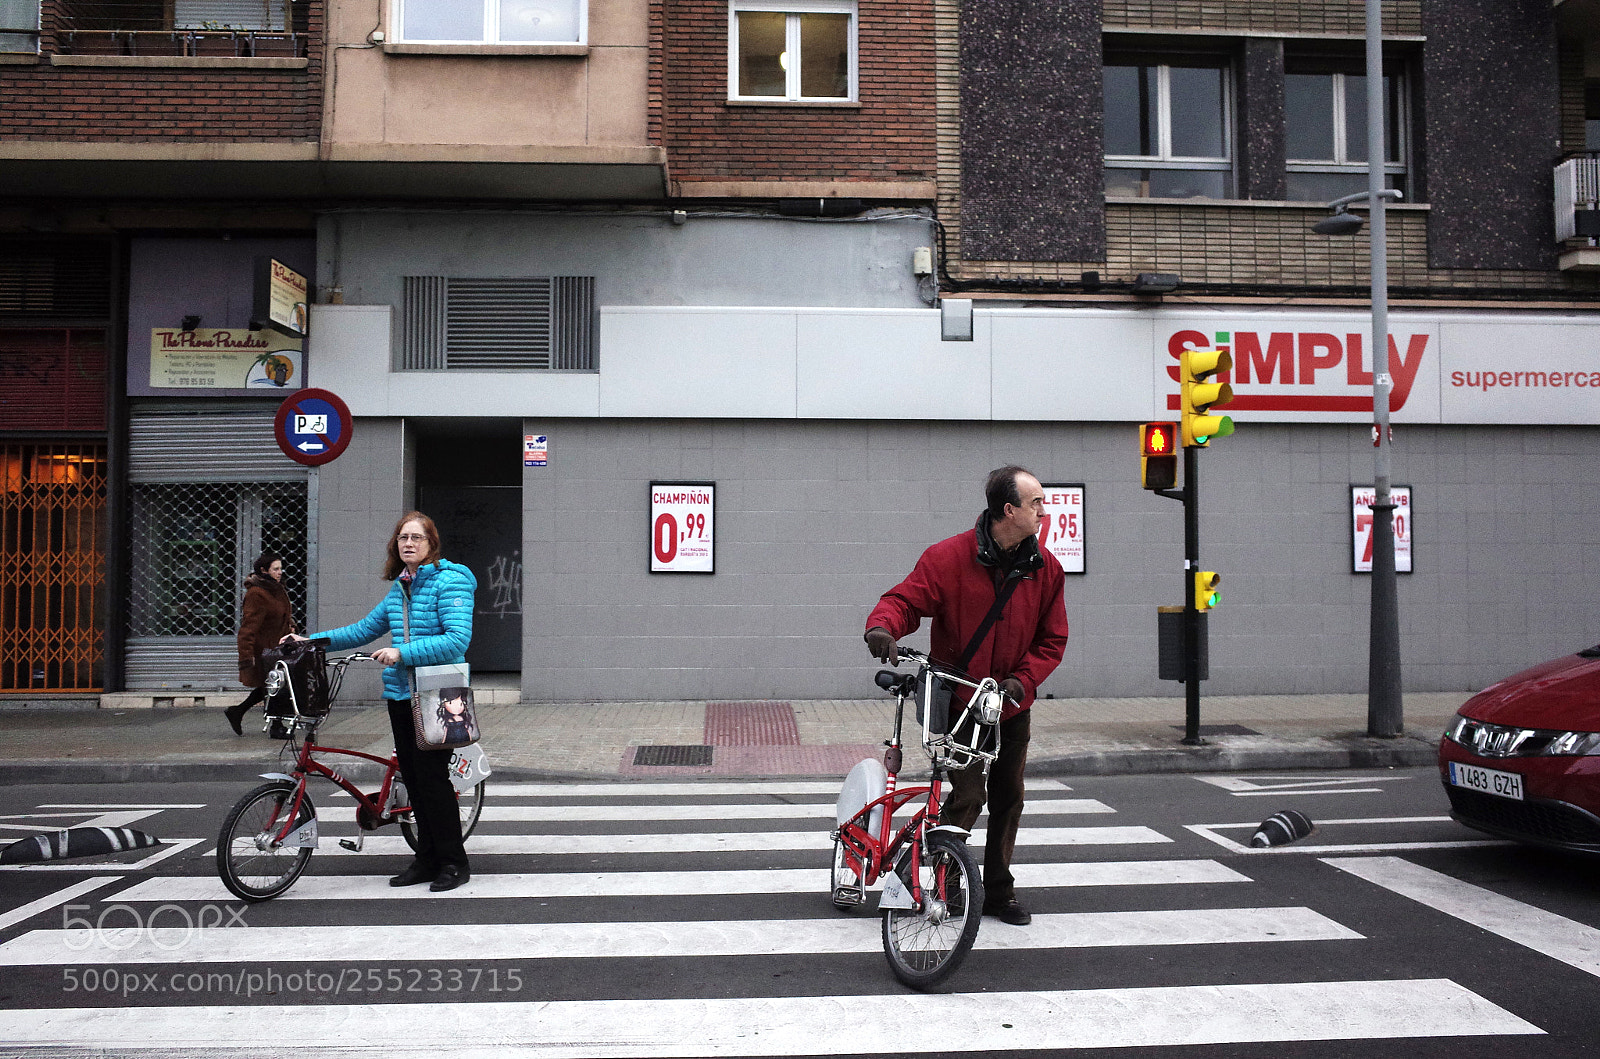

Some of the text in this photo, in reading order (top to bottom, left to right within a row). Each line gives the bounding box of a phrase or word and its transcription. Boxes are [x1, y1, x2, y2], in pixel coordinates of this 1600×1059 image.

[156, 331, 269, 348] The Phone Paradise
[1451, 370, 1600, 392] supermerca
[298, 416, 307, 432] P
[653, 489, 710, 505] CHAMPIÑÓN
[1043, 493, 1080, 505] LETE
[654, 512, 706, 563] 0,99
[1460, 766, 1520, 798] 1483 GZH
